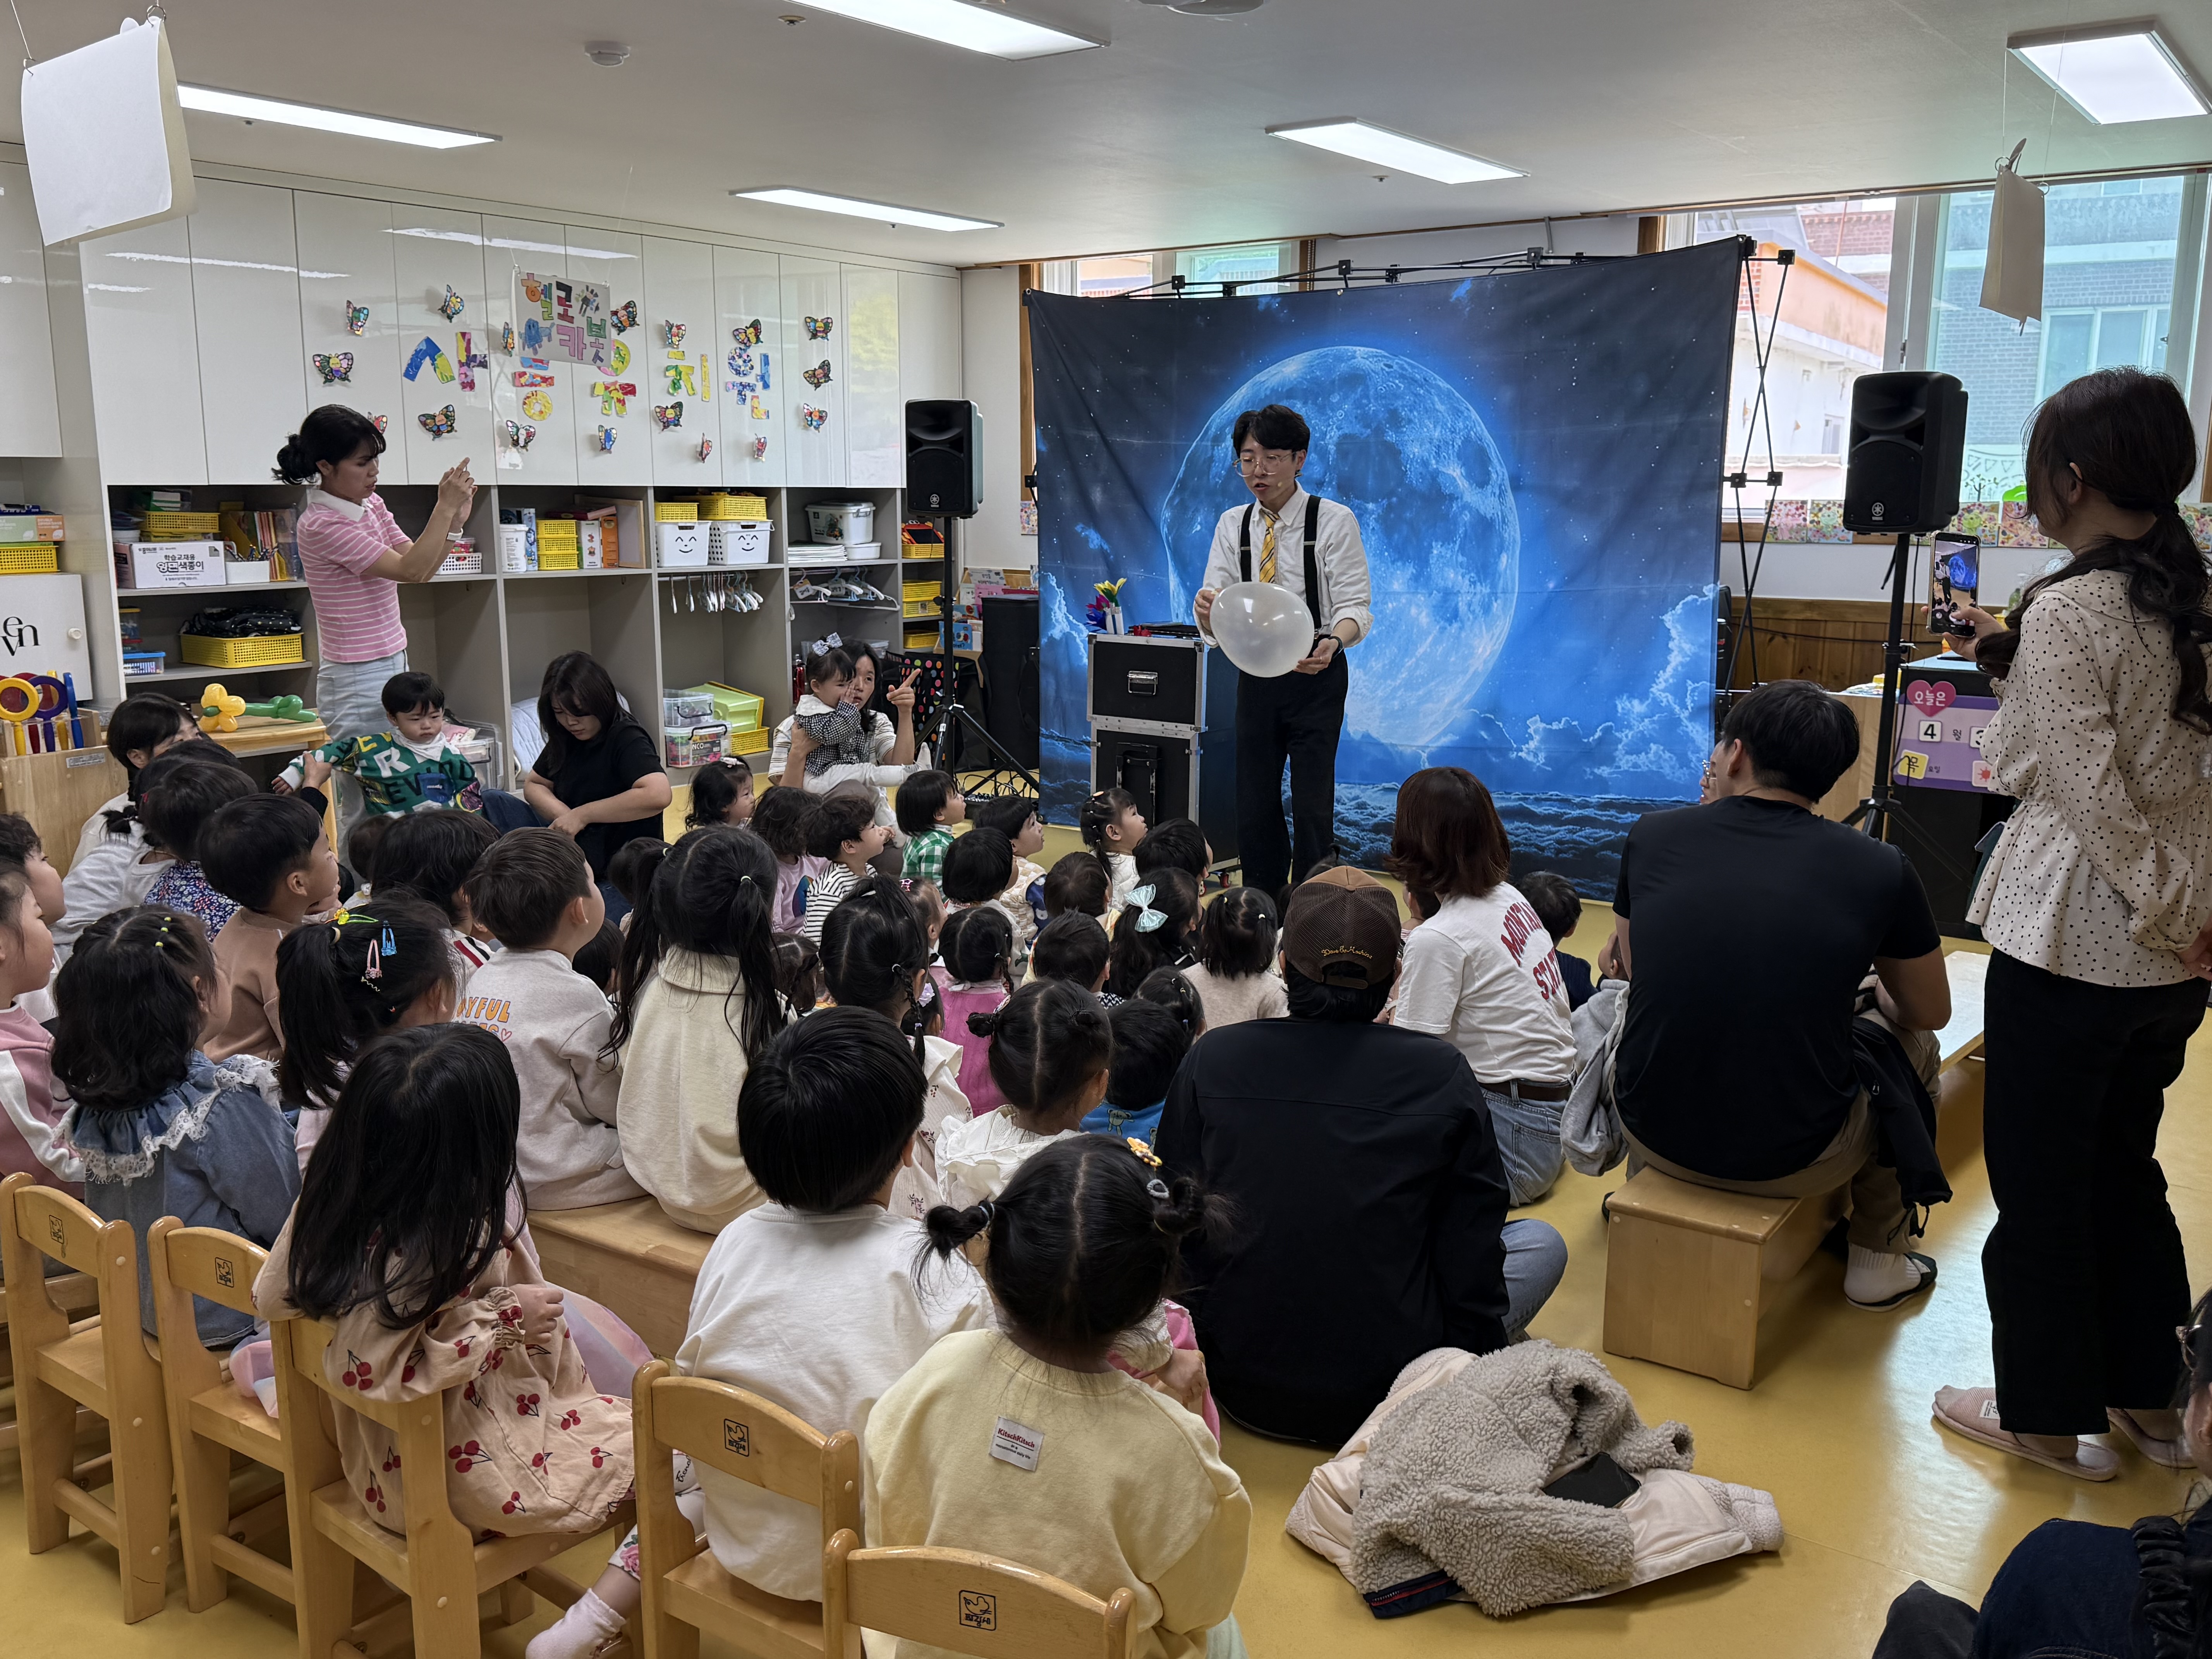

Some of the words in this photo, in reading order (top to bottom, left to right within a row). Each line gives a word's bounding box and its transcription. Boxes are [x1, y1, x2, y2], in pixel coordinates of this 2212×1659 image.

[1914, 690, 1946, 706] 오늘은
[1924, 724, 1936, 739] 4
[998, 1428, 1035, 1448] KitschKitsch
